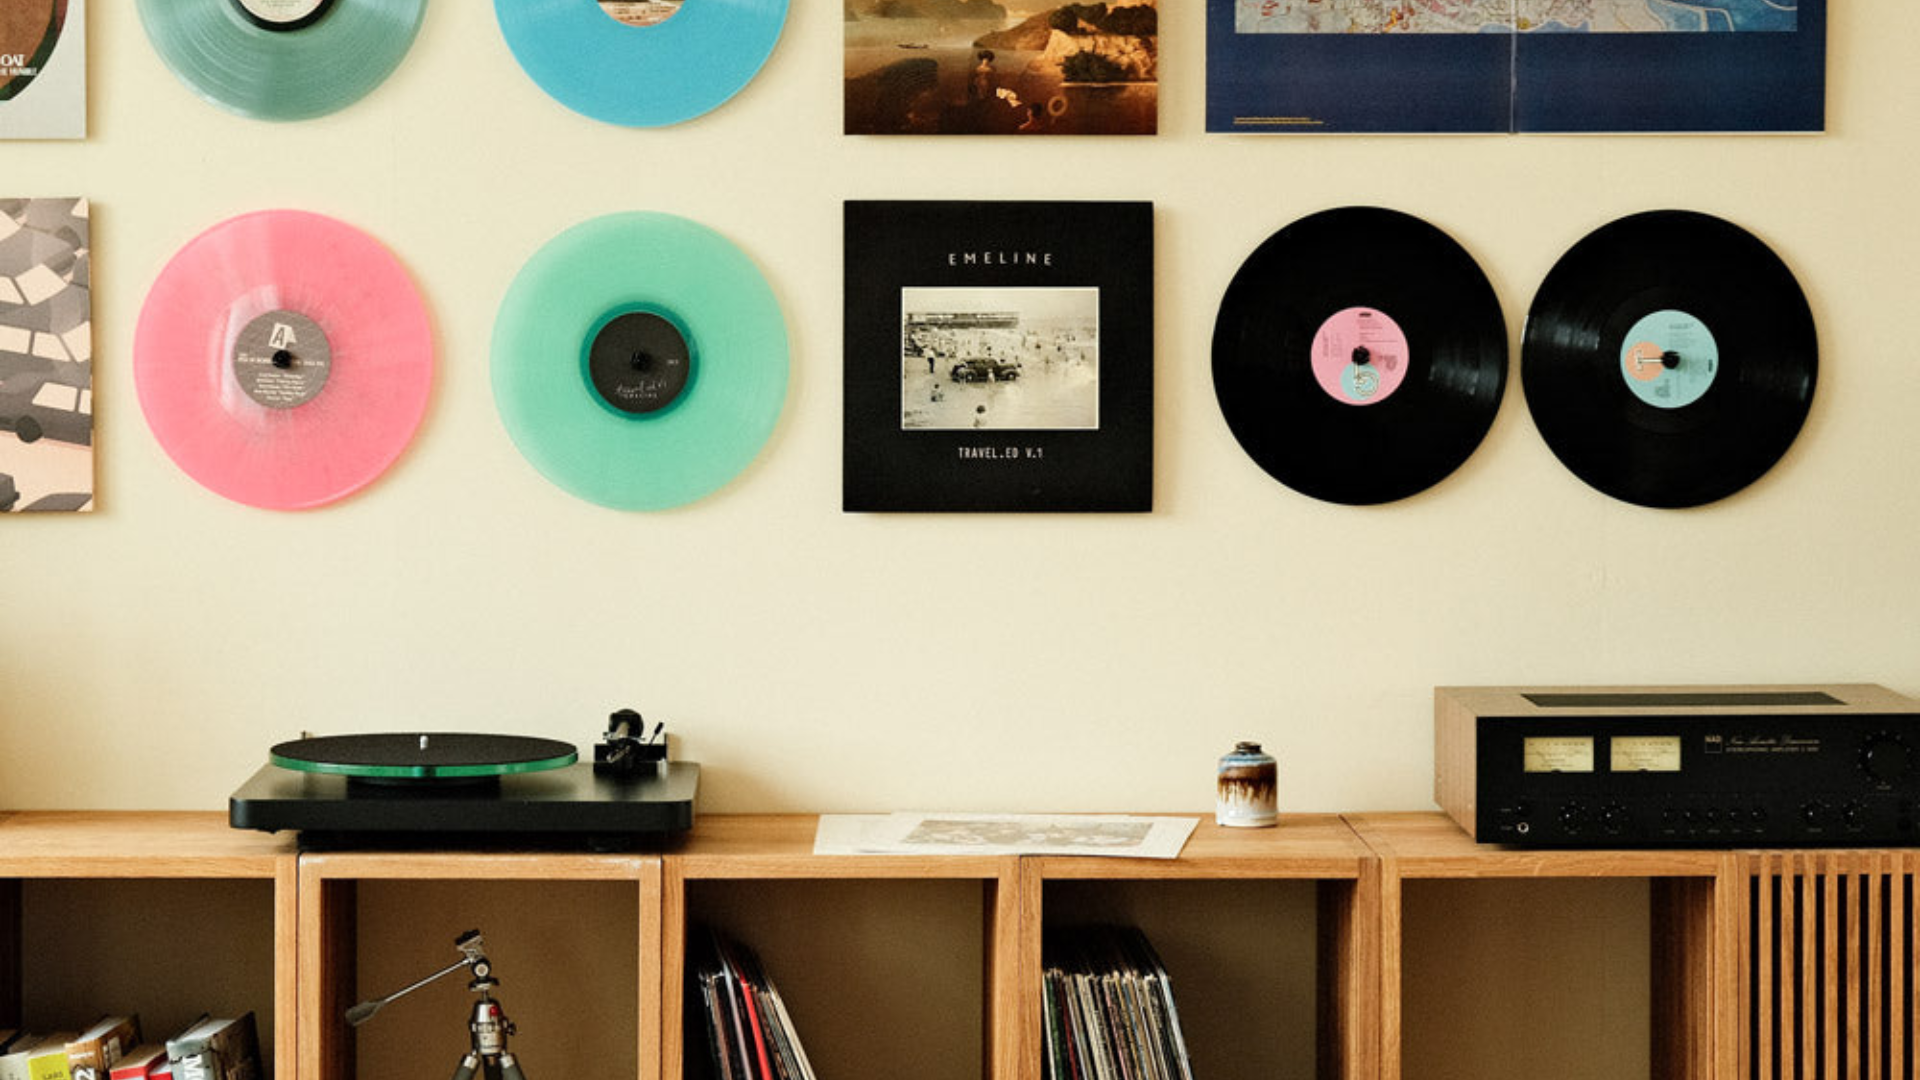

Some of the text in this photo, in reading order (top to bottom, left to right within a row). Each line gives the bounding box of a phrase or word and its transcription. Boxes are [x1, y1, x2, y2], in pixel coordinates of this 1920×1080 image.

[948, 251, 1053, 266] EMELINE
[958, 447, 1043, 459] TRAVEL.ED V.1
